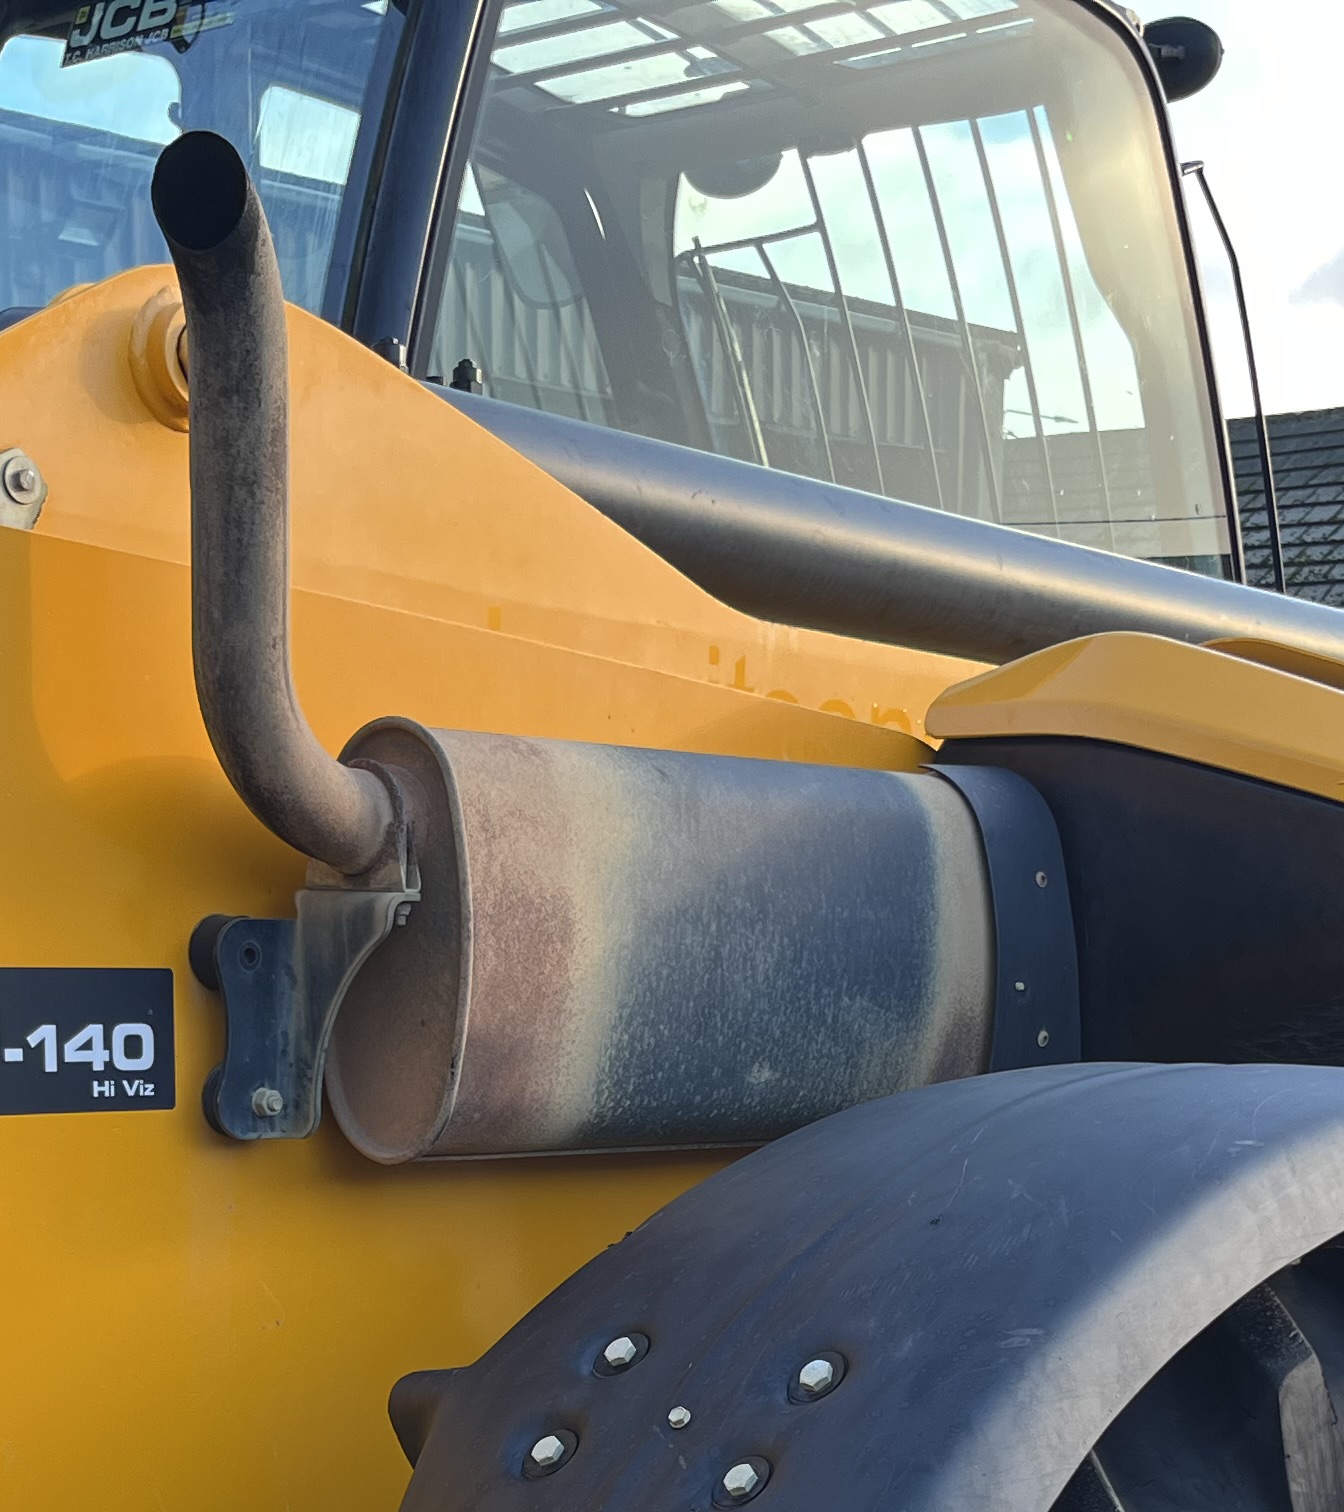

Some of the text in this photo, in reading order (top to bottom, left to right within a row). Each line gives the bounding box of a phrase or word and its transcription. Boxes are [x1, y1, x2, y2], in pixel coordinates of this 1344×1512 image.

[69, 0, 177, 48] JCB
[147, 28, 170, 44] JCB
[92, 1079, 155, 1097] Hi Viz
